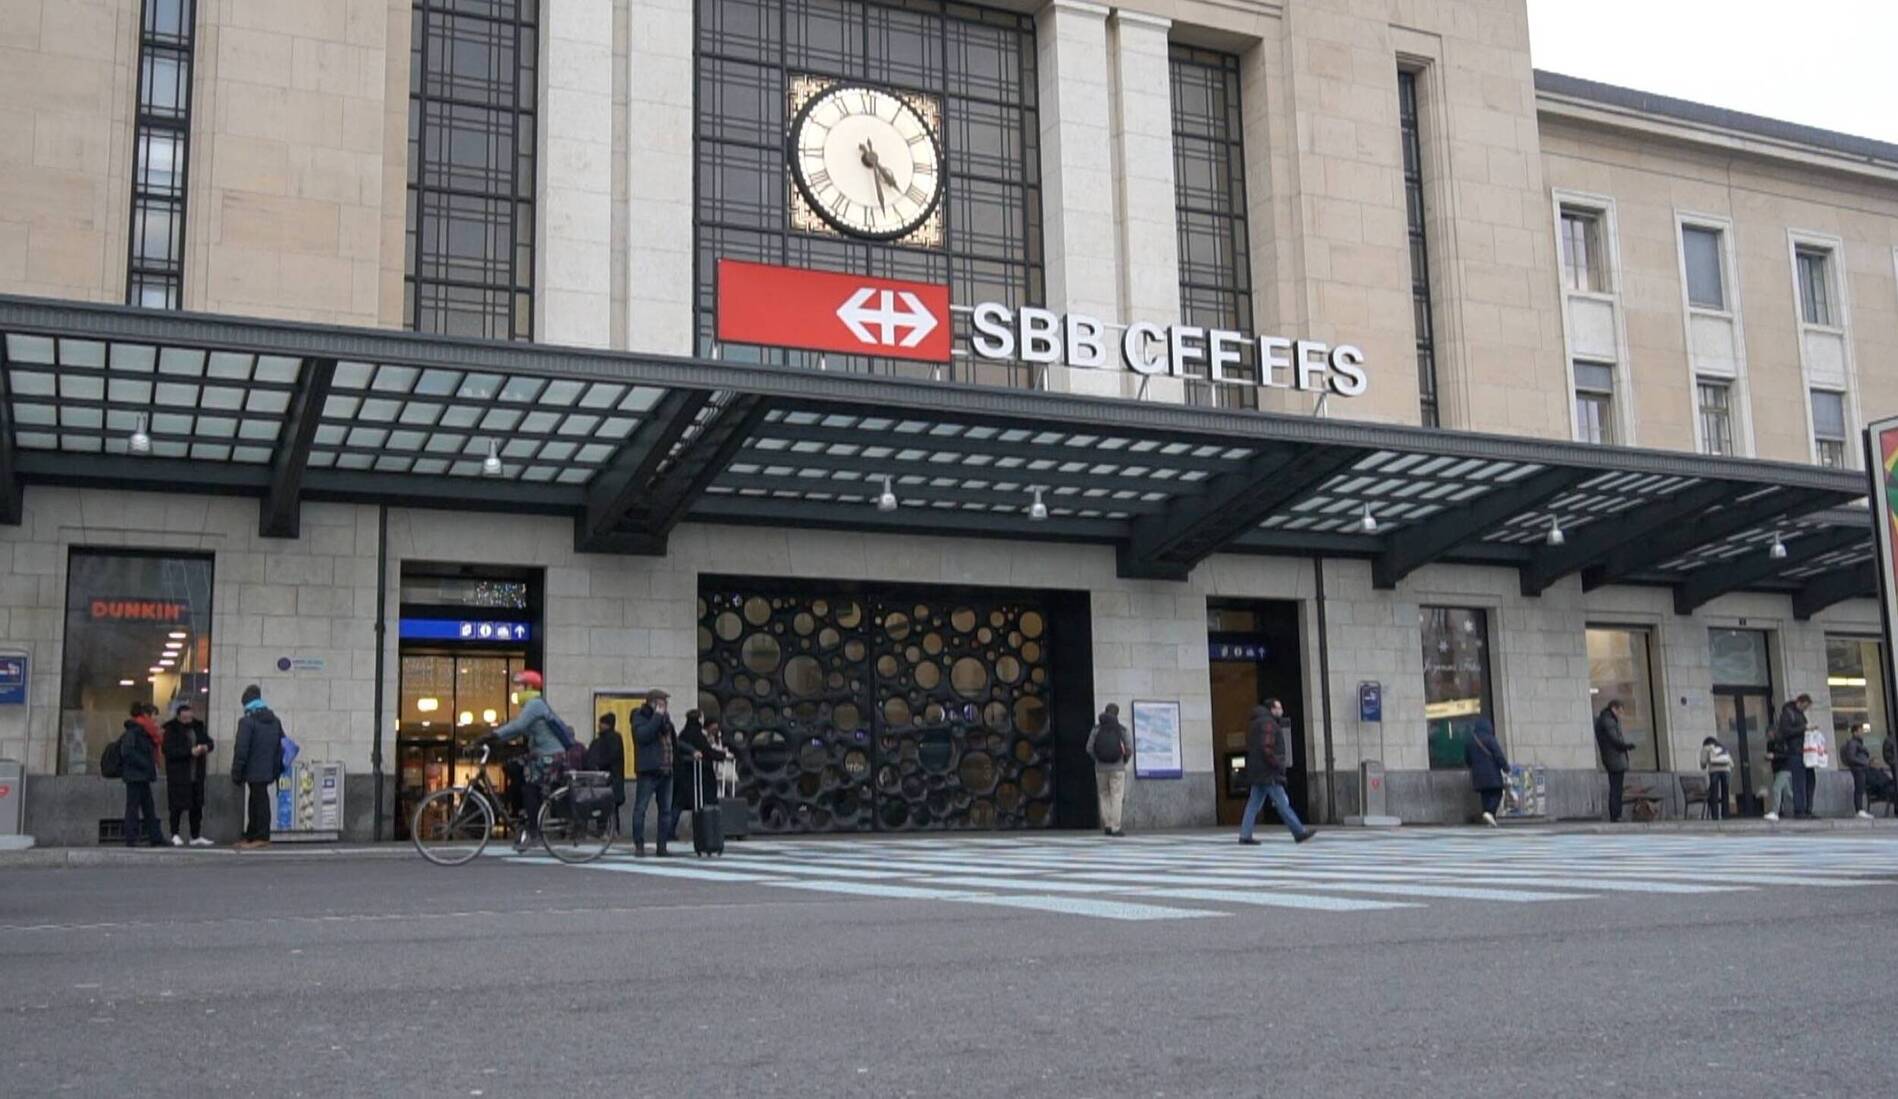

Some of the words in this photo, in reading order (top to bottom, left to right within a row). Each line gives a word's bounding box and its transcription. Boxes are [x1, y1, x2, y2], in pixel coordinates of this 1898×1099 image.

[971, 302, 1105, 367] SBB
[1122, 322, 1241, 381] CFF
[1258, 334, 1369, 397] FFS
